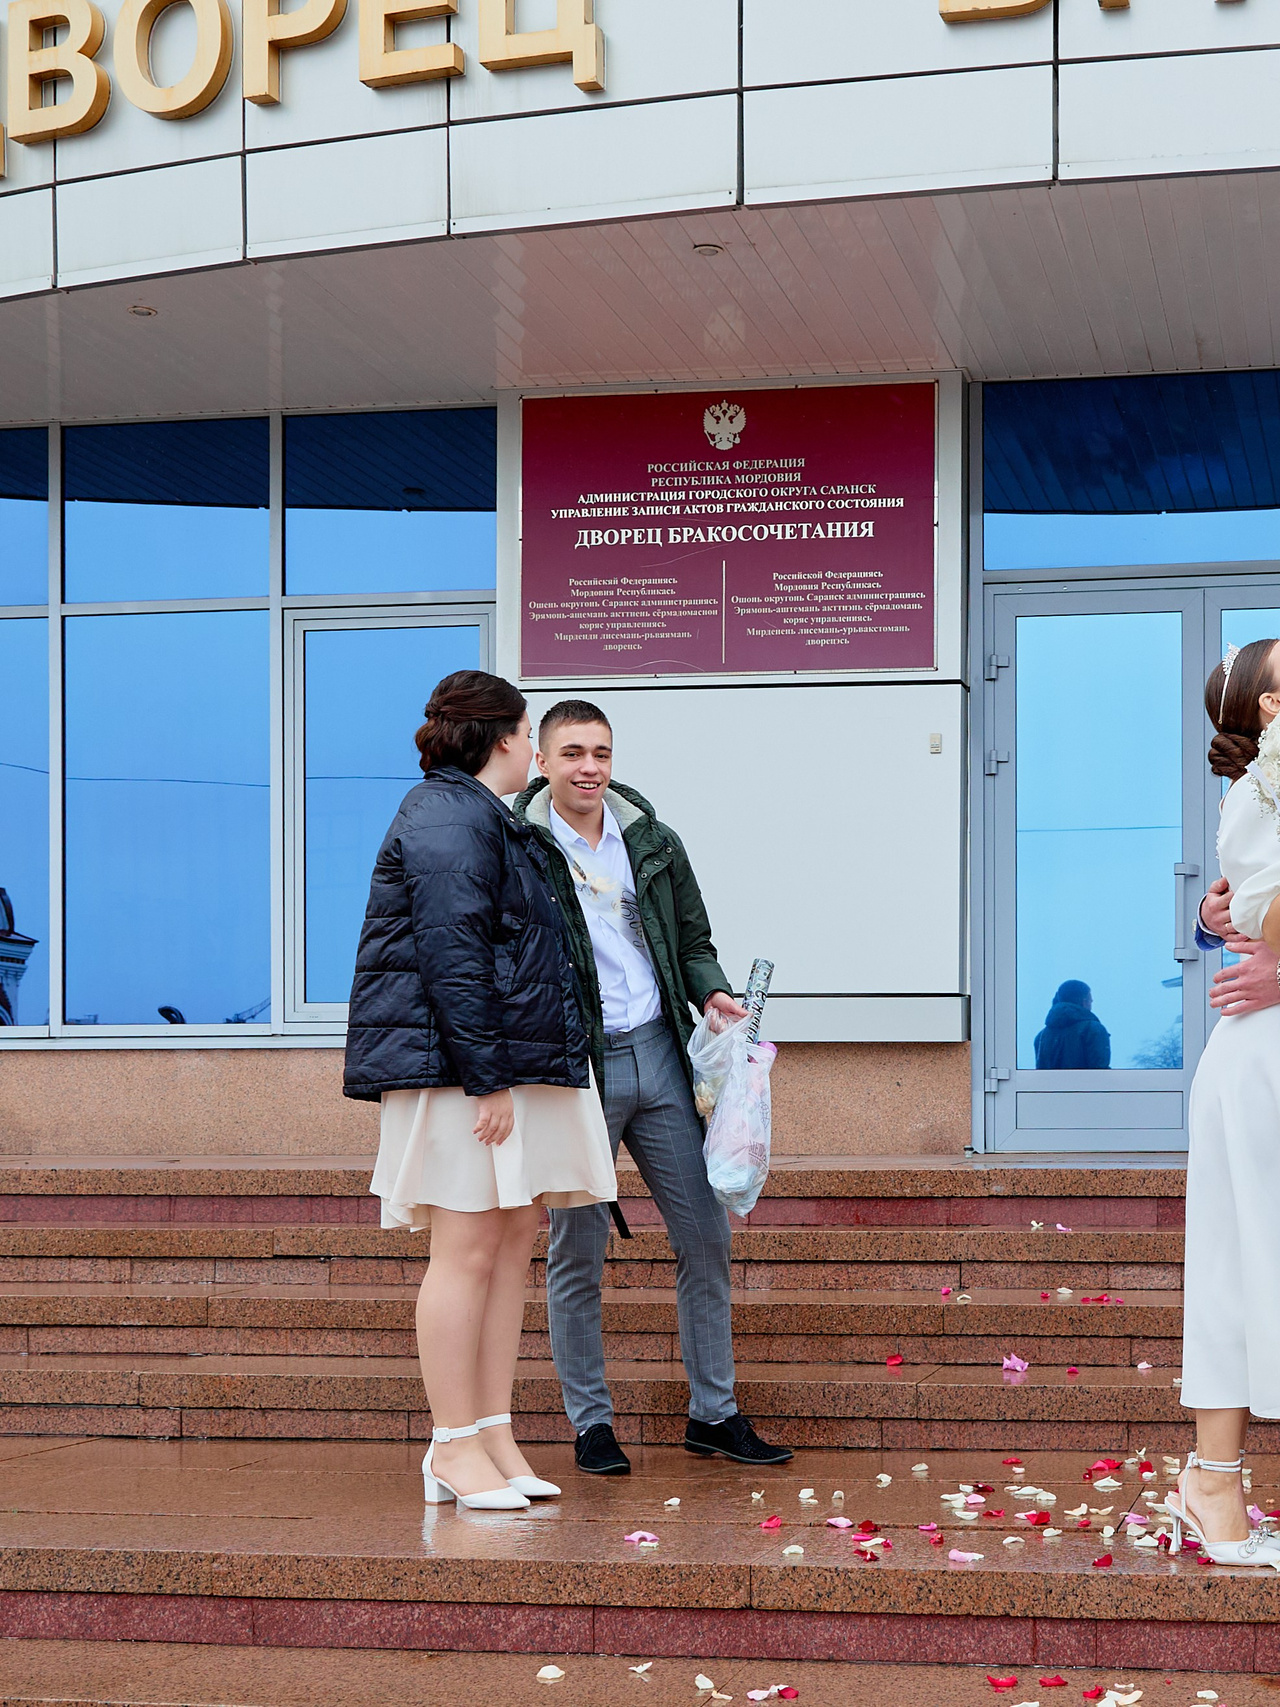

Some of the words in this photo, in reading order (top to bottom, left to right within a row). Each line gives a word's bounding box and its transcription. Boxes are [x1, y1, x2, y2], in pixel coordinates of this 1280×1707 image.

[0, 0, 604, 178] ВОРЕЦ
[647, 460, 730, 473] РОССИЙСКАЯ
[732, 458, 805, 470] ФЕДЕРАЦИЯ
[651, 475, 732, 487] РЕСПУБЛИКА
[734, 472, 801, 484] МОРДОВИЯ
[577, 491, 686, 505] АДМИНИСТРАЦИЯ
[688, 488, 768, 500] ГОРОДСКОГО
[771, 485, 817, 497] ОКРУГА
[820, 484, 876, 495] САРАНСК
[551, 506, 629, 519] УПРАВЛЕНИЕ
[631, 505, 680, 516] ЗАПИСИ
[683, 503, 724, 514] АКТОВ
[726, 500, 824, 514] ГРАЖДАНСКОГО
[827, 497, 904, 509] СОСТОЯНИЯ
[574, 527, 662, 550] ДВОРЕЦ
[667, 521, 875, 544] БРАКОСОЧЕТАНИЯ
[620, 576, 678, 587] Федерациясь
[772, 571, 823, 581] Российской
[824, 570, 884, 581] Федерациясь
[570, 589, 614, 599] Мордовия
[616, 586, 676, 598] Республикась
[774, 583, 819, 593] Мордовия
[820, 581, 882, 592] Республикась
[560, 601, 600, 610] округонь
[601, 599, 639, 609] Саранск
[640, 597, 718, 608] администрациясь
[764, 595, 805, 605] округонь
[806, 593, 844, 603] Саранск
[846, 591, 926, 602] администрациясь
[579, 621, 604, 630] коряс
[783, 615, 808, 625] коряс
